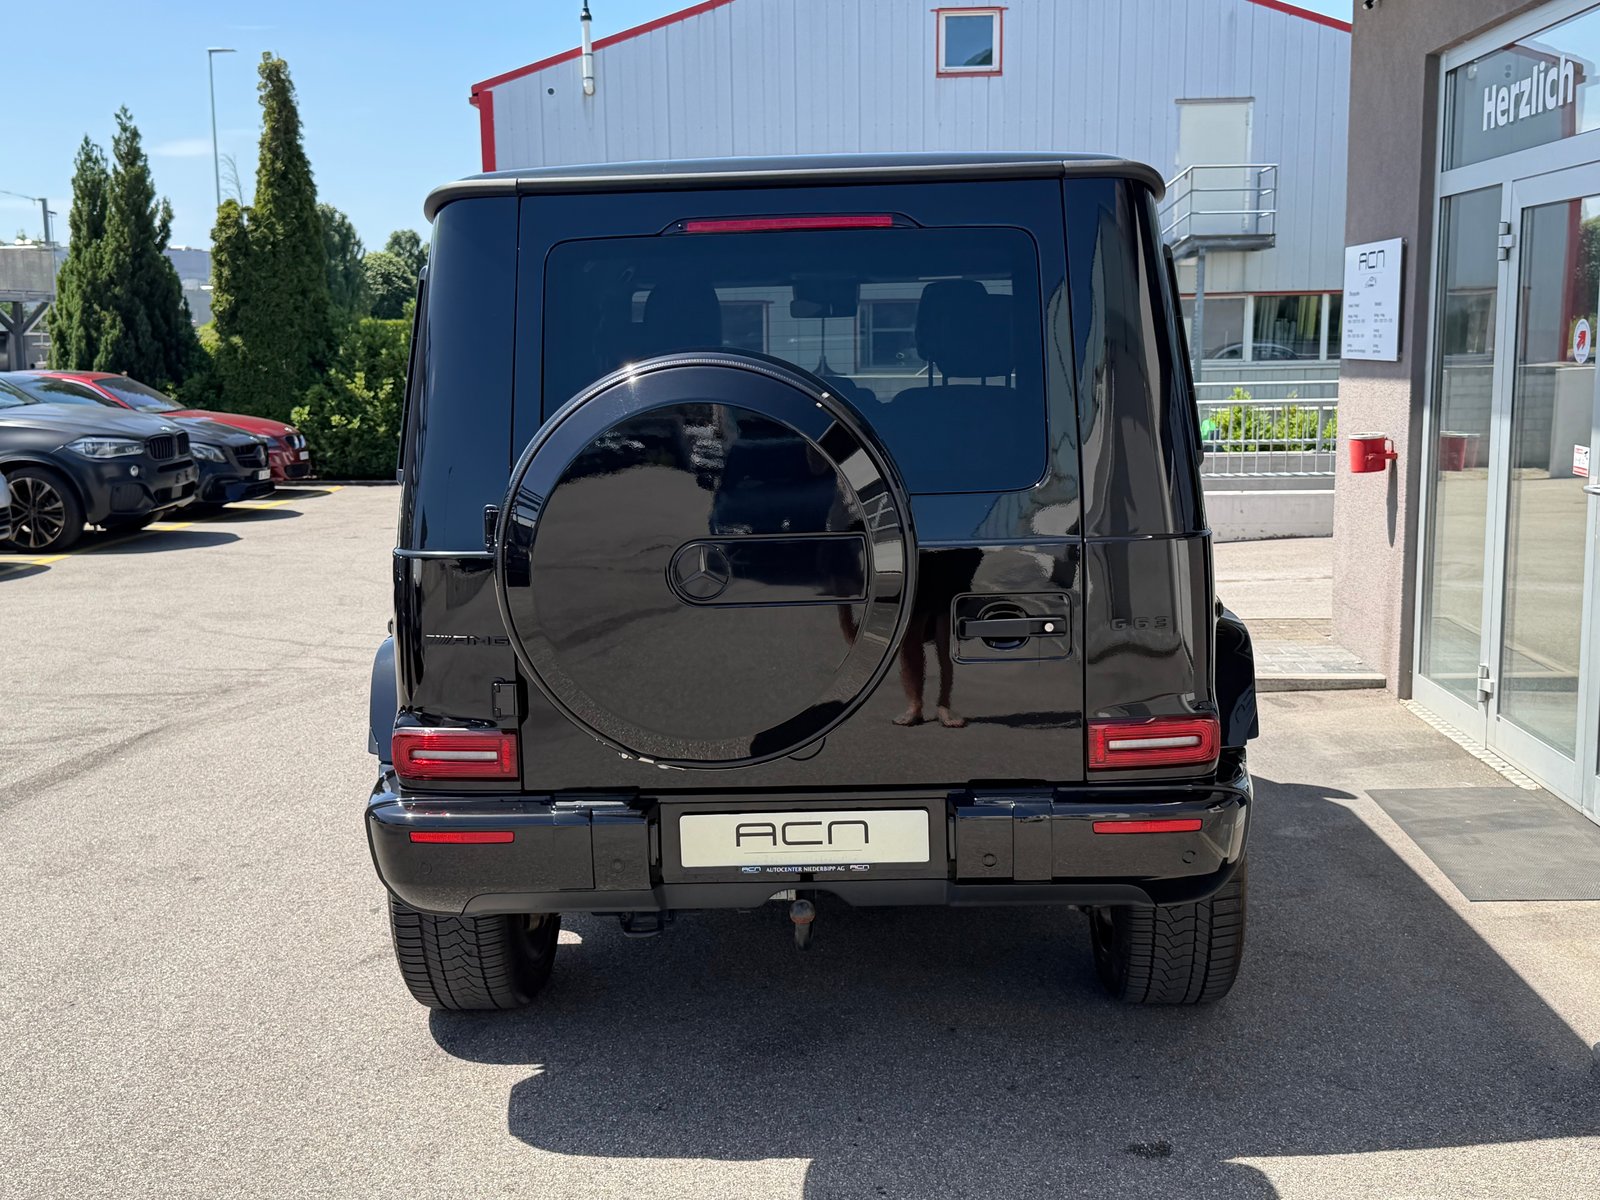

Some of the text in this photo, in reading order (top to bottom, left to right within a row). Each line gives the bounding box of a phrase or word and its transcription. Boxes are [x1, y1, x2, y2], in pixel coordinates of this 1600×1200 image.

[1482, 54, 1575, 132] Herzlich
[735, 820, 869, 847] ACN
[765, 865, 802, 873] AUTOCENTER
[803, 864, 836, 872] NIEDERBIPP
[836, 864, 846, 872] AG
